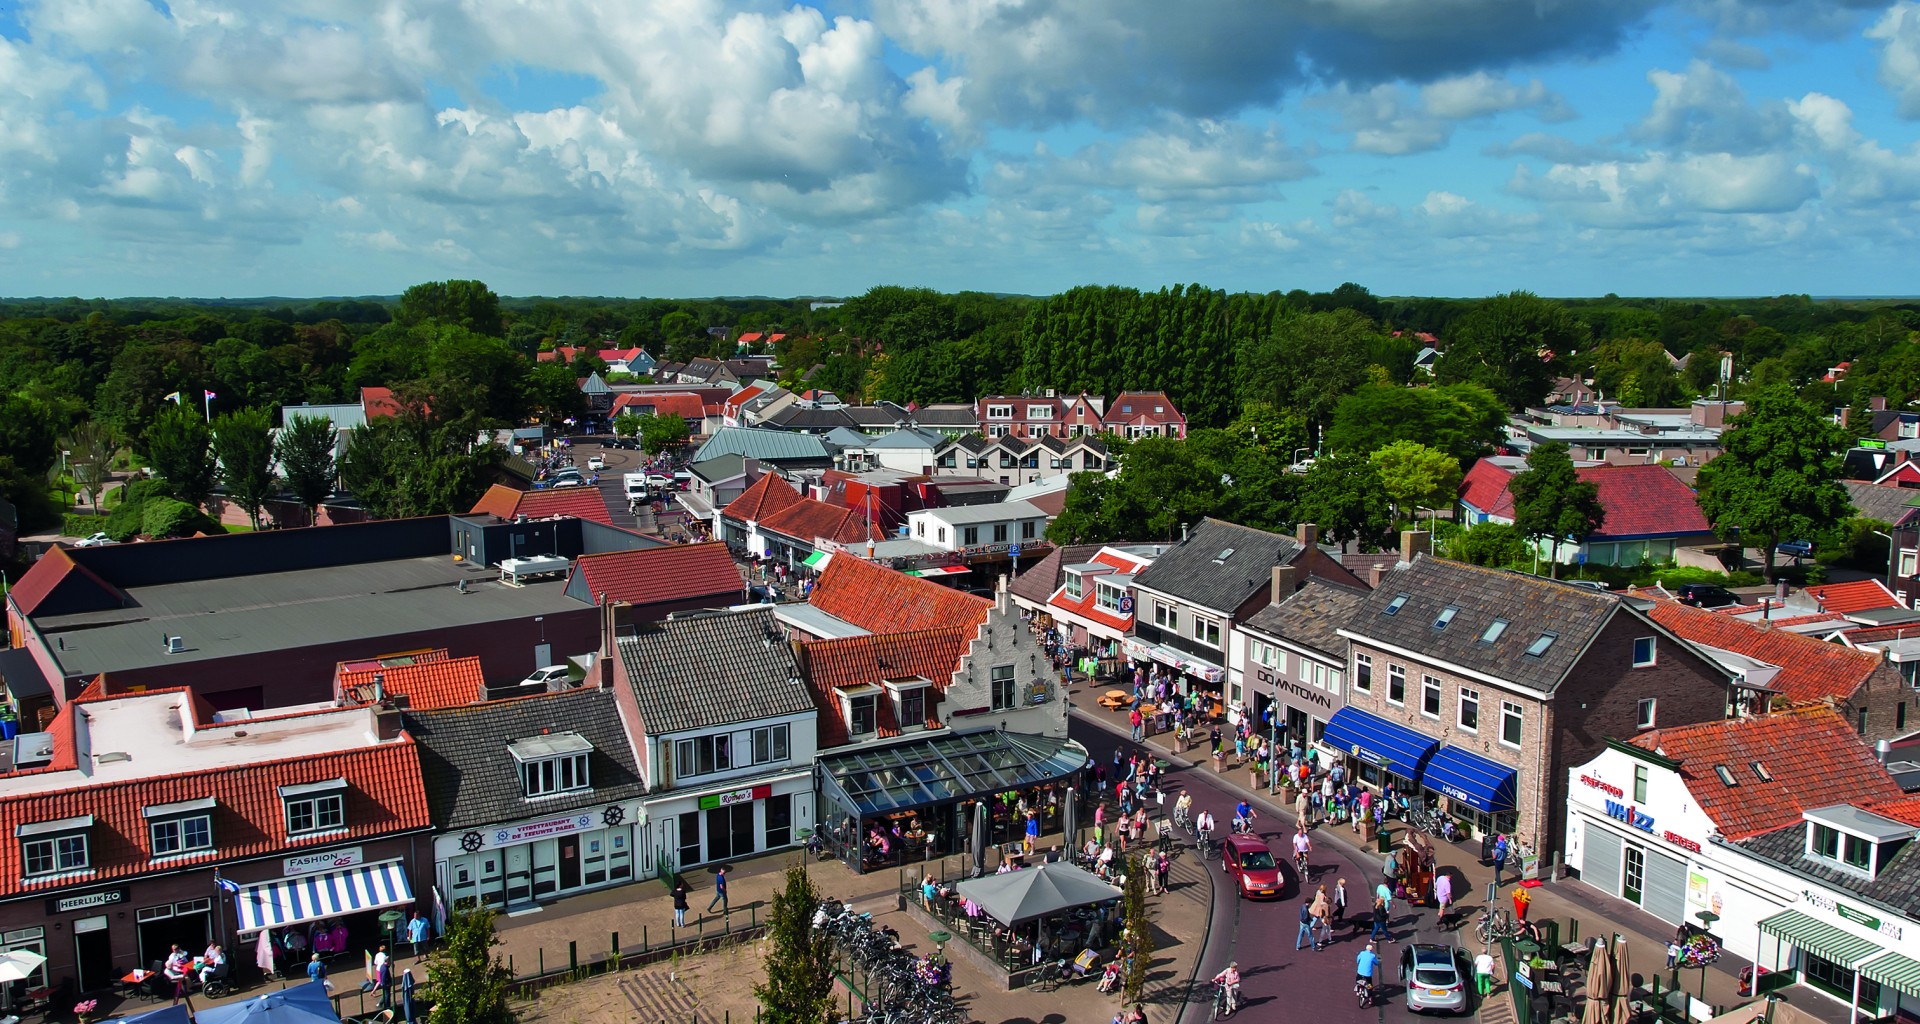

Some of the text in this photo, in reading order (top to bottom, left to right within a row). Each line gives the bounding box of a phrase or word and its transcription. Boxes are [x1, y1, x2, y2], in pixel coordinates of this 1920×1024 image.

[1258, 670, 1331, 709] DOWNTOWN
[721, 790, 752, 804] Romeo's
[1663, 830, 1701, 853] BURGER
[290, 853, 338, 867] FASHION
[61, 895, 104, 908] HEERLIJK
[105, 892, 120, 901] ZO
